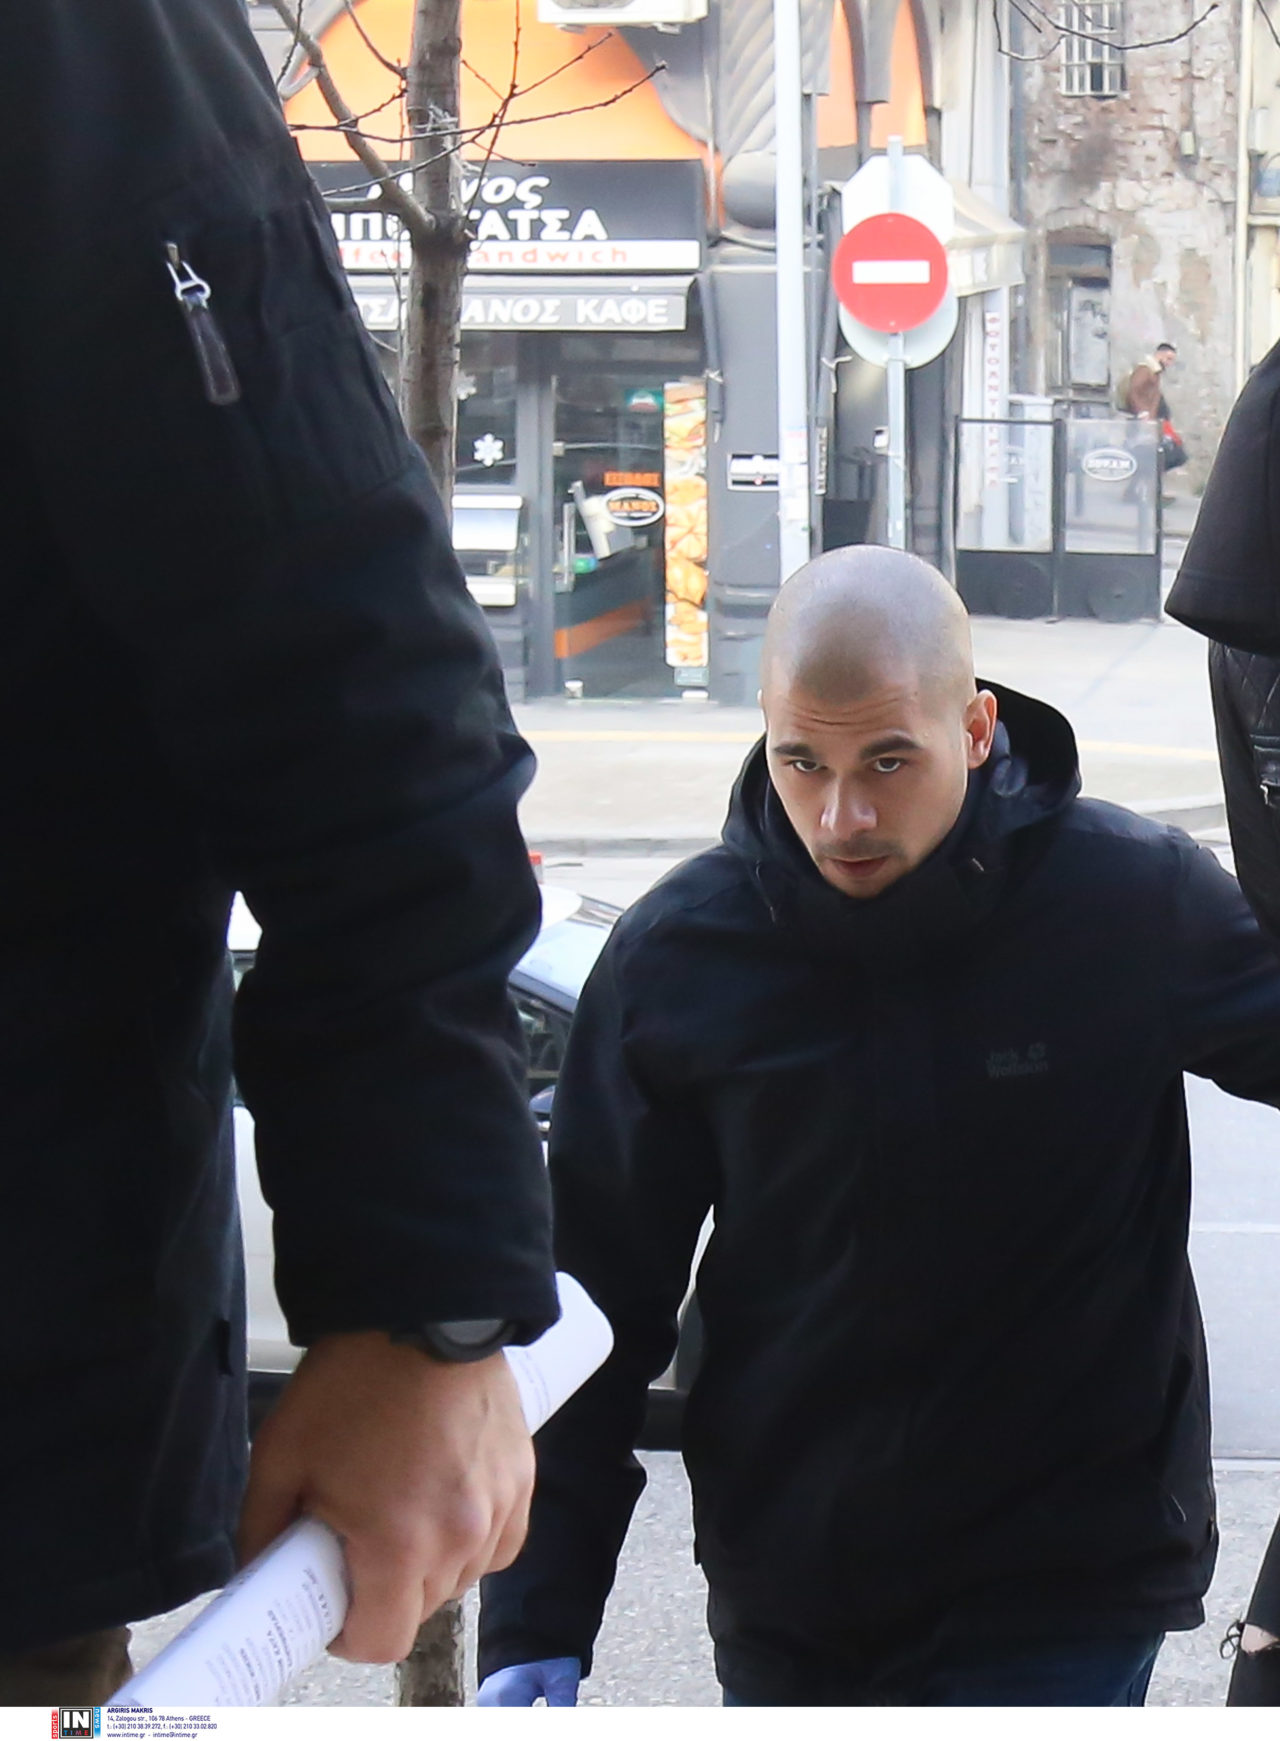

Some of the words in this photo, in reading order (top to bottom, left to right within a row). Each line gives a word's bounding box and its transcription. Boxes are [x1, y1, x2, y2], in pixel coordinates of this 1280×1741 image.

[331, 209, 609, 241] ΠΟΑΤΣΑ
[475, 248, 627, 264] andwich
[461, 299, 561, 325] ΑΝΟΣ
[576, 298, 668, 325] ΚΑΦΕ
